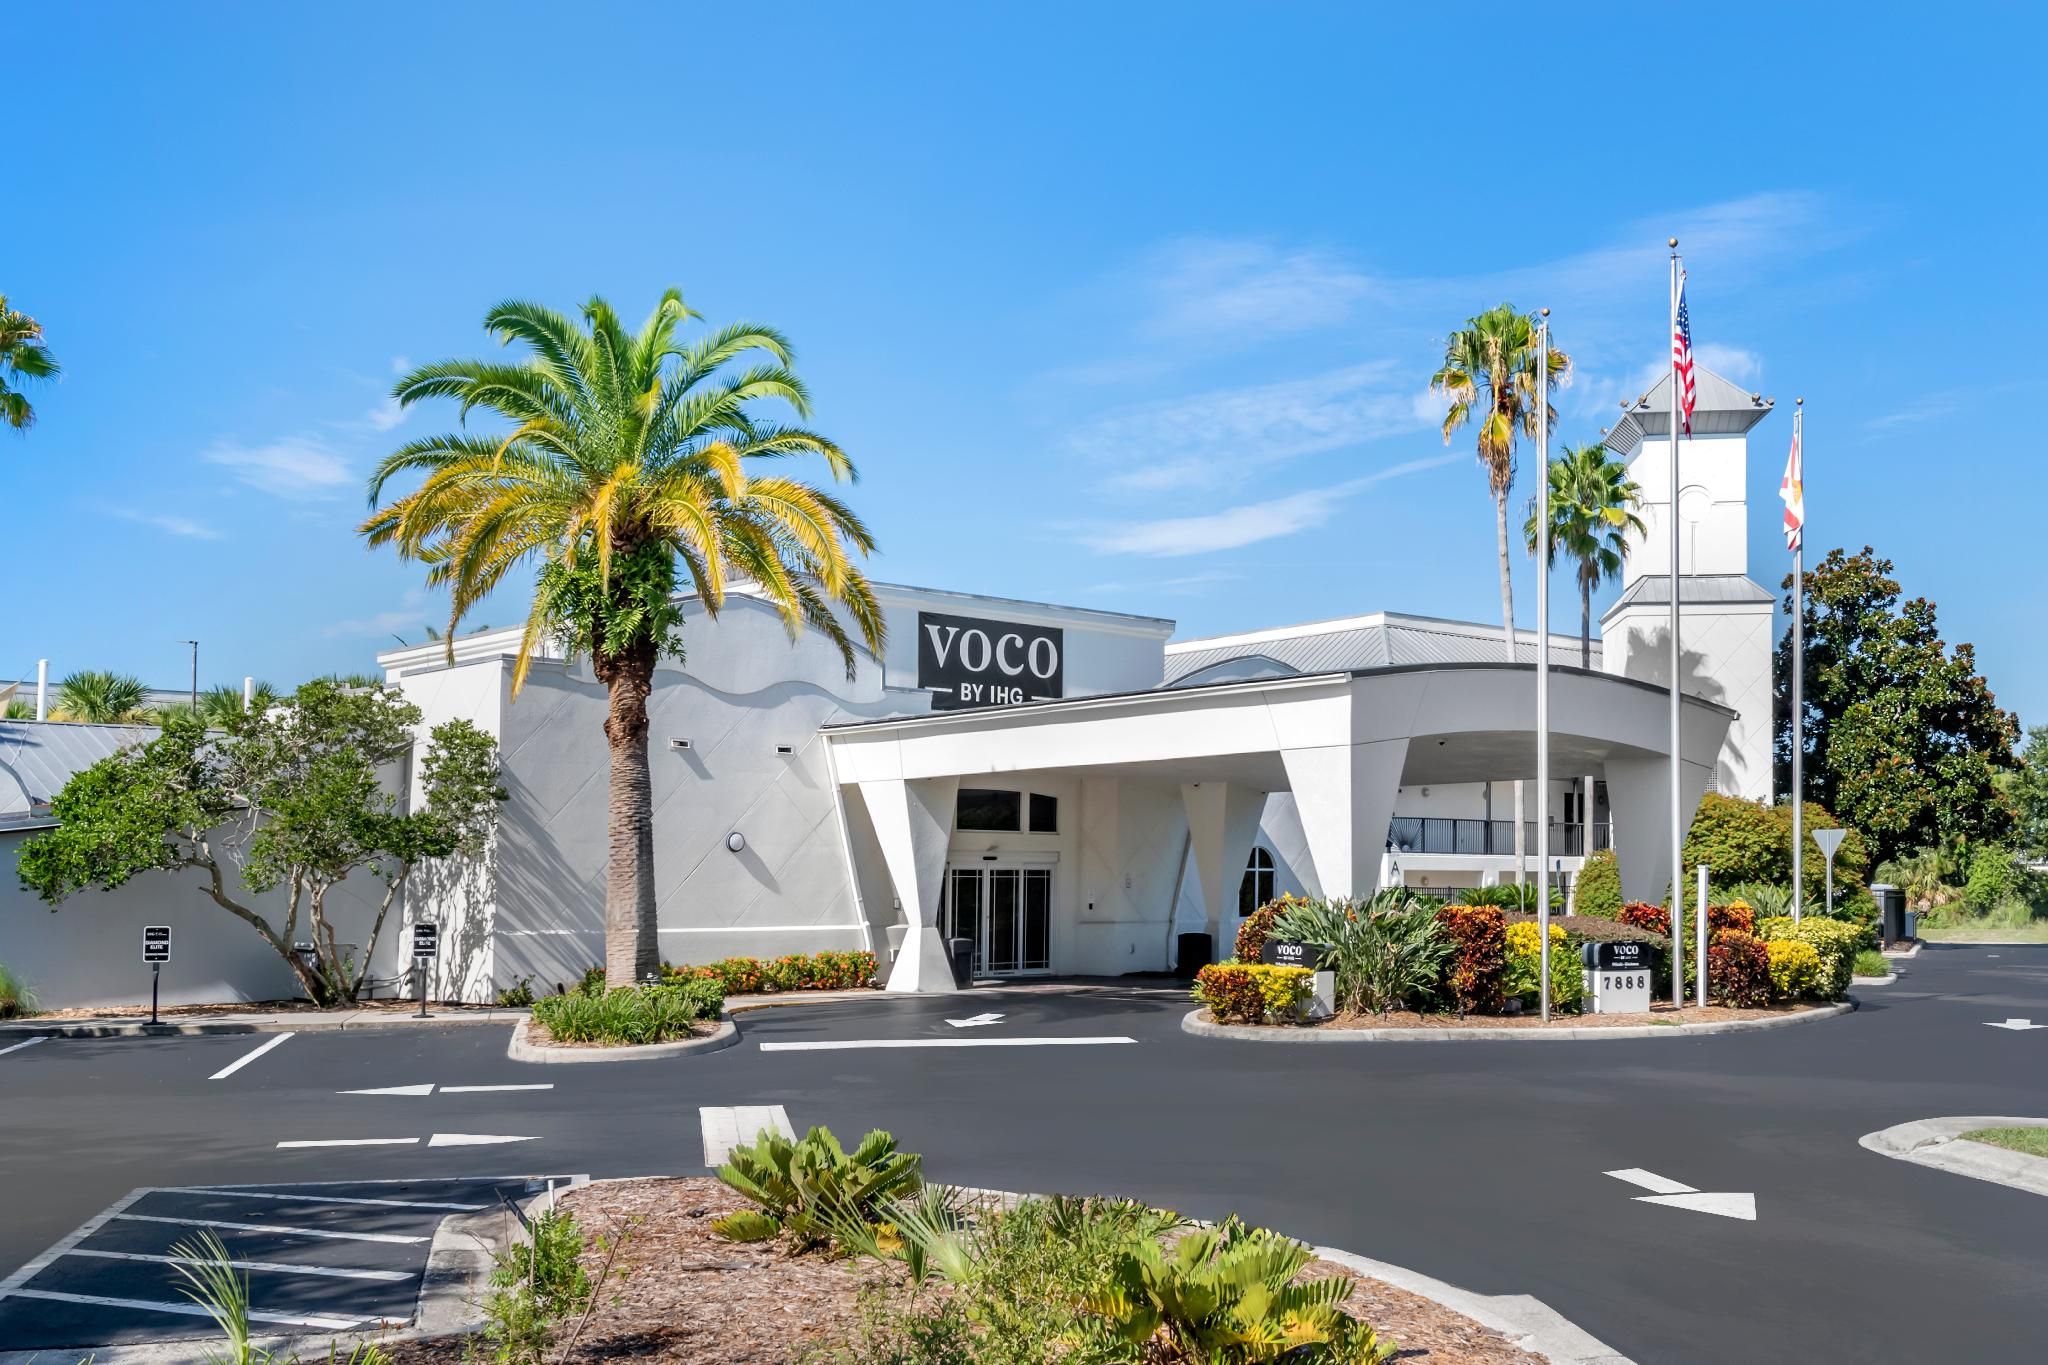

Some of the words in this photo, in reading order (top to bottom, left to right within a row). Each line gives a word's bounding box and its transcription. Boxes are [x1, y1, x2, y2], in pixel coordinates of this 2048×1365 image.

[924, 623, 1058, 679] VOCO
[960, 682, 984, 702] BY
[990, 685, 1024, 705] IHG
[1391, 860, 1400, 876] A
[1276, 945, 1303, 956] VOCO
[1613, 945, 1639, 955] VOCO
[1604, 975, 1645, 991] 7888
